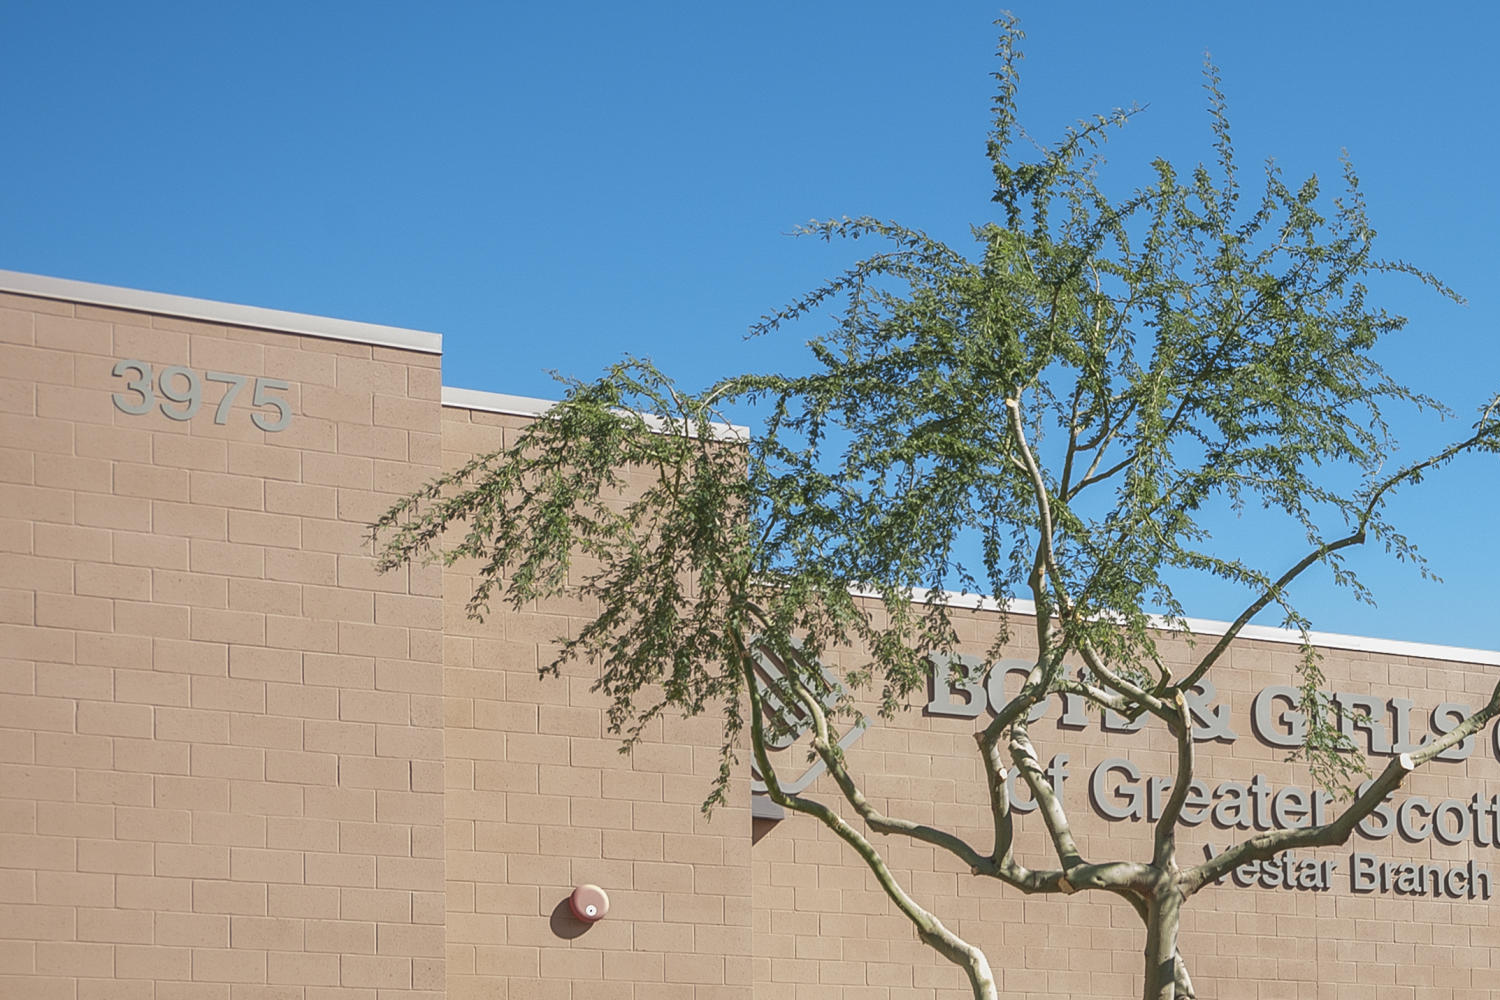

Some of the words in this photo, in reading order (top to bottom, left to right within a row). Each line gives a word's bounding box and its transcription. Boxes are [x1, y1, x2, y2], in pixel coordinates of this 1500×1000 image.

[111, 358, 293, 433] 3975
[1168, 676, 1238, 742] &
[1005, 753, 1071, 813] of
[1089, 757, 1335, 831] Greater
[1350, 851, 1493, 900] Branch
